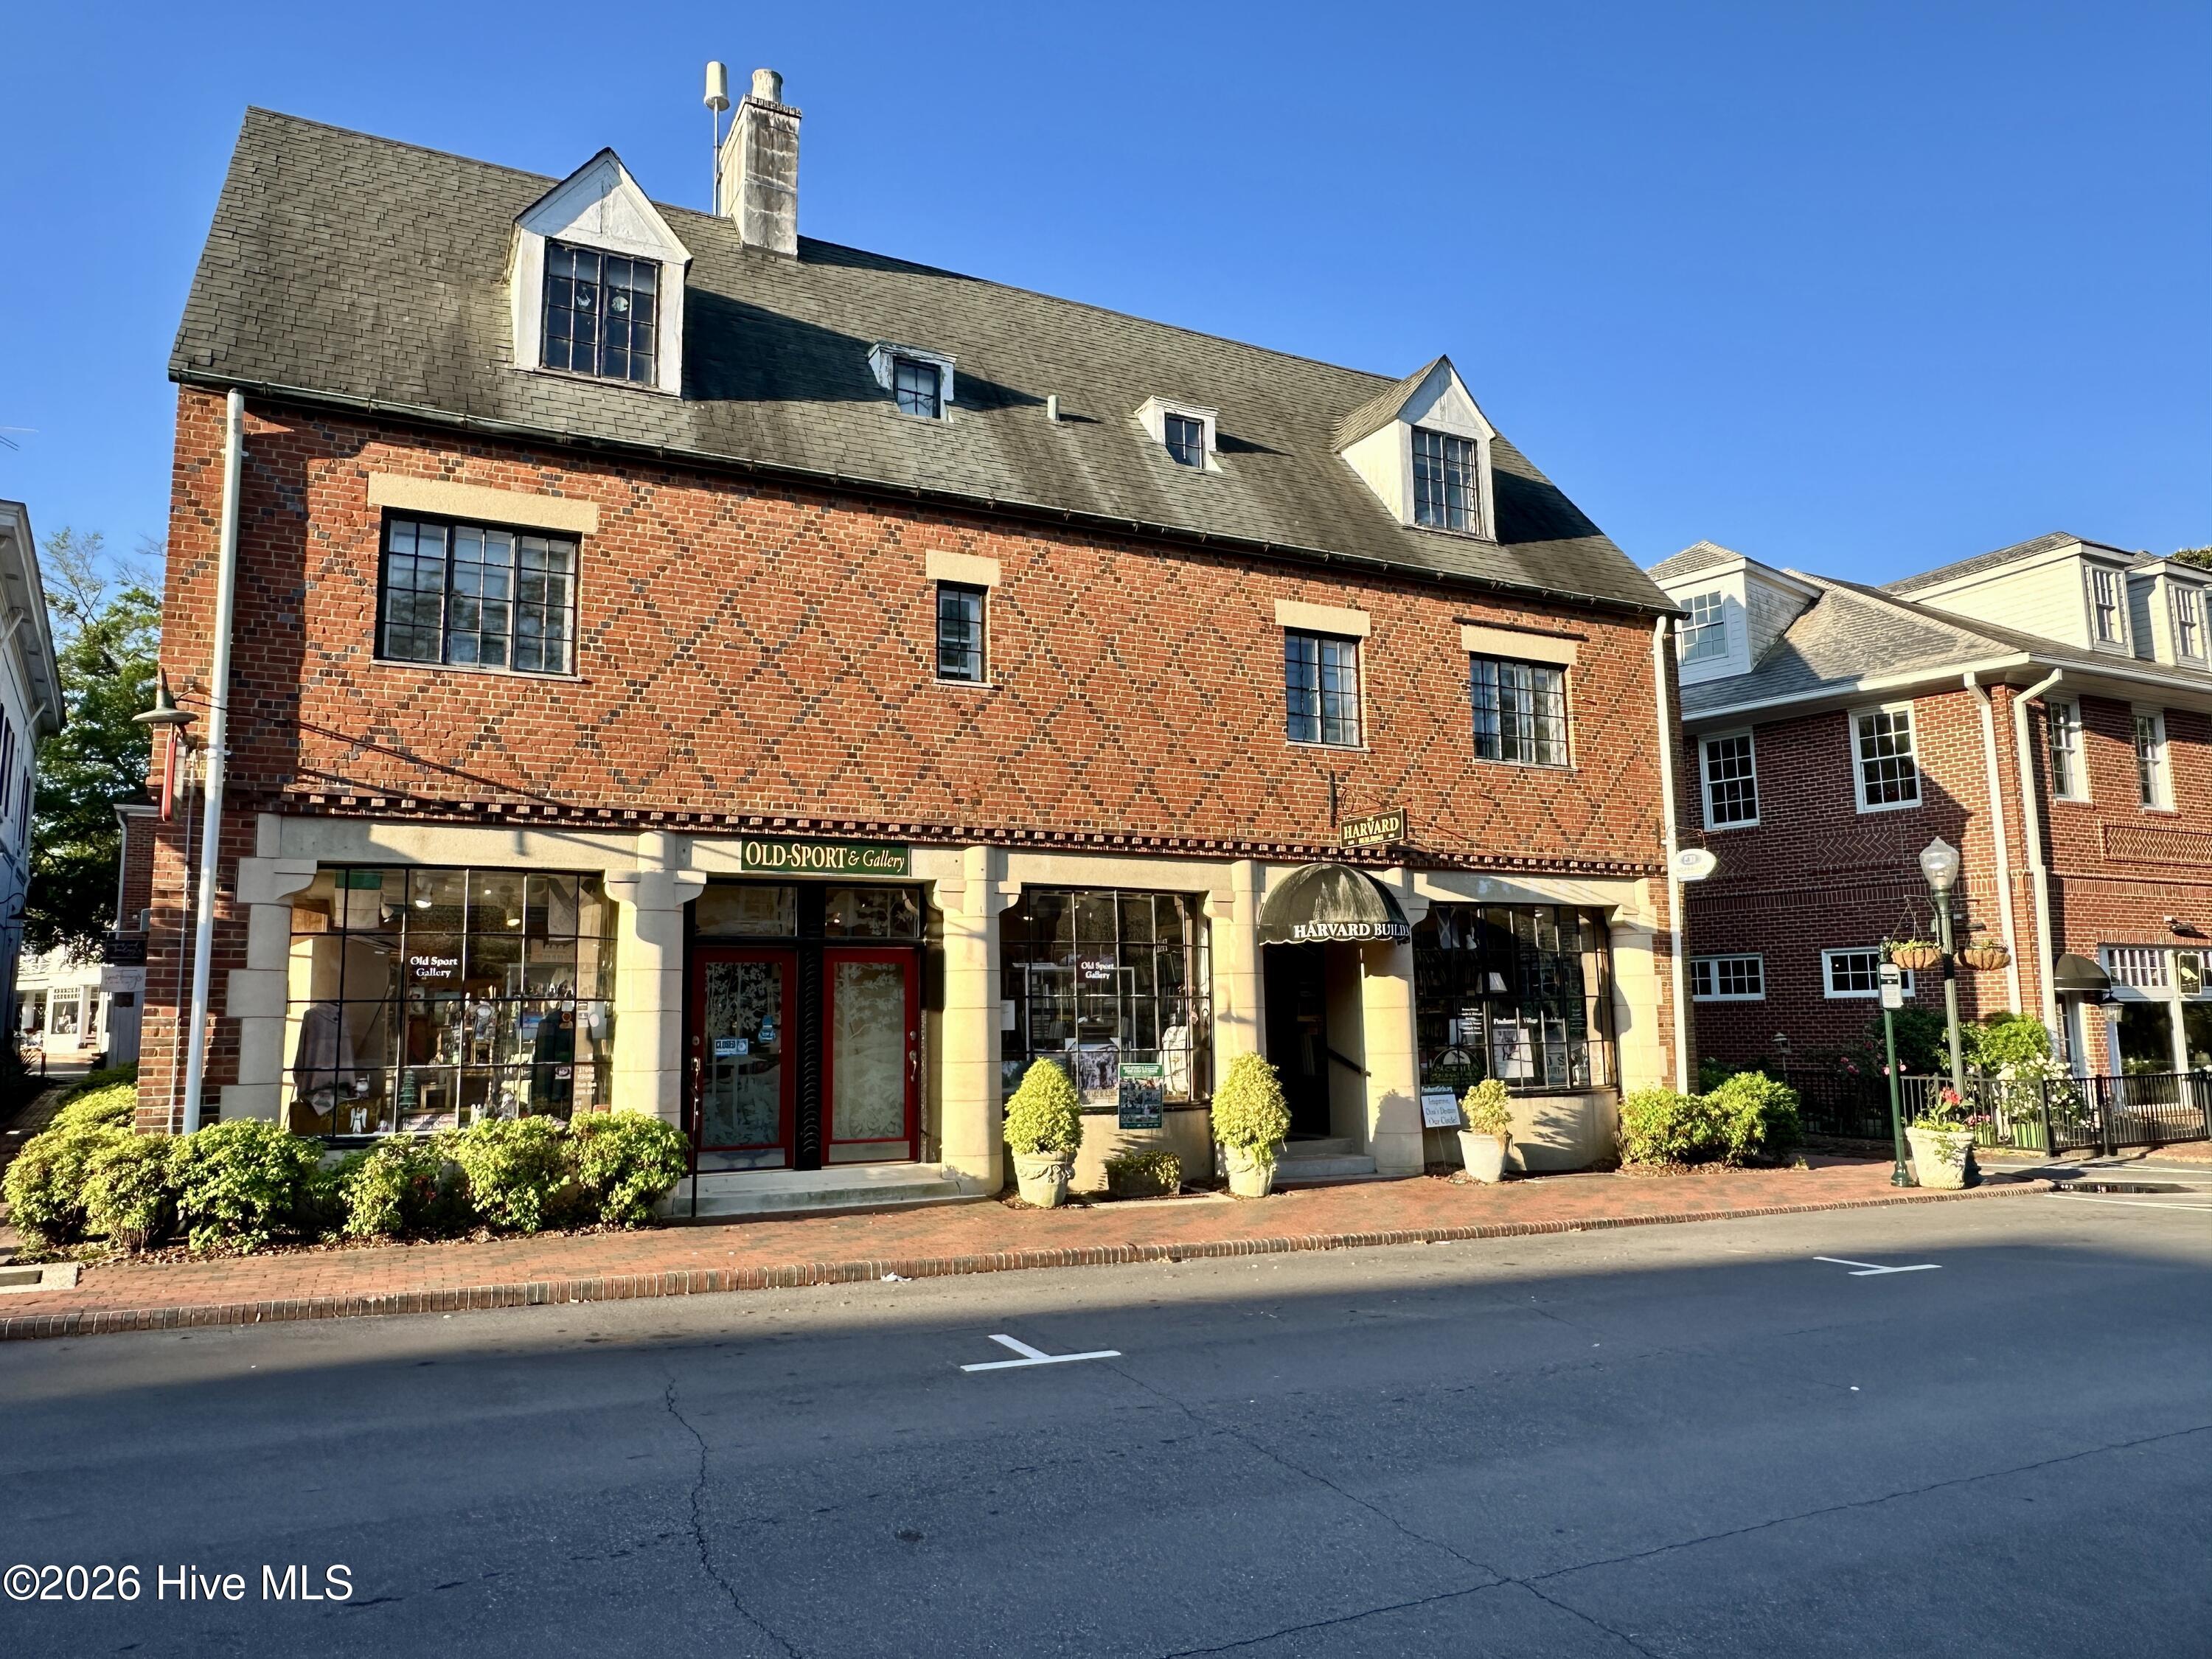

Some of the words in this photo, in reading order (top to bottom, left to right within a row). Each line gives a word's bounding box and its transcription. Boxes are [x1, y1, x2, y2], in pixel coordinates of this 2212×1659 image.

[1343, 817, 1399, 840] HARVARD
[848, 850, 860, 866] &
[863, 849, 905, 873] Gallery
[1293, 923, 1371, 938] HARVARD
[410, 956, 429, 965] Old
[431, 956, 458, 967] Sport
[1081, 961, 1095, 970] Old
[416, 967, 451, 978] Gallery
